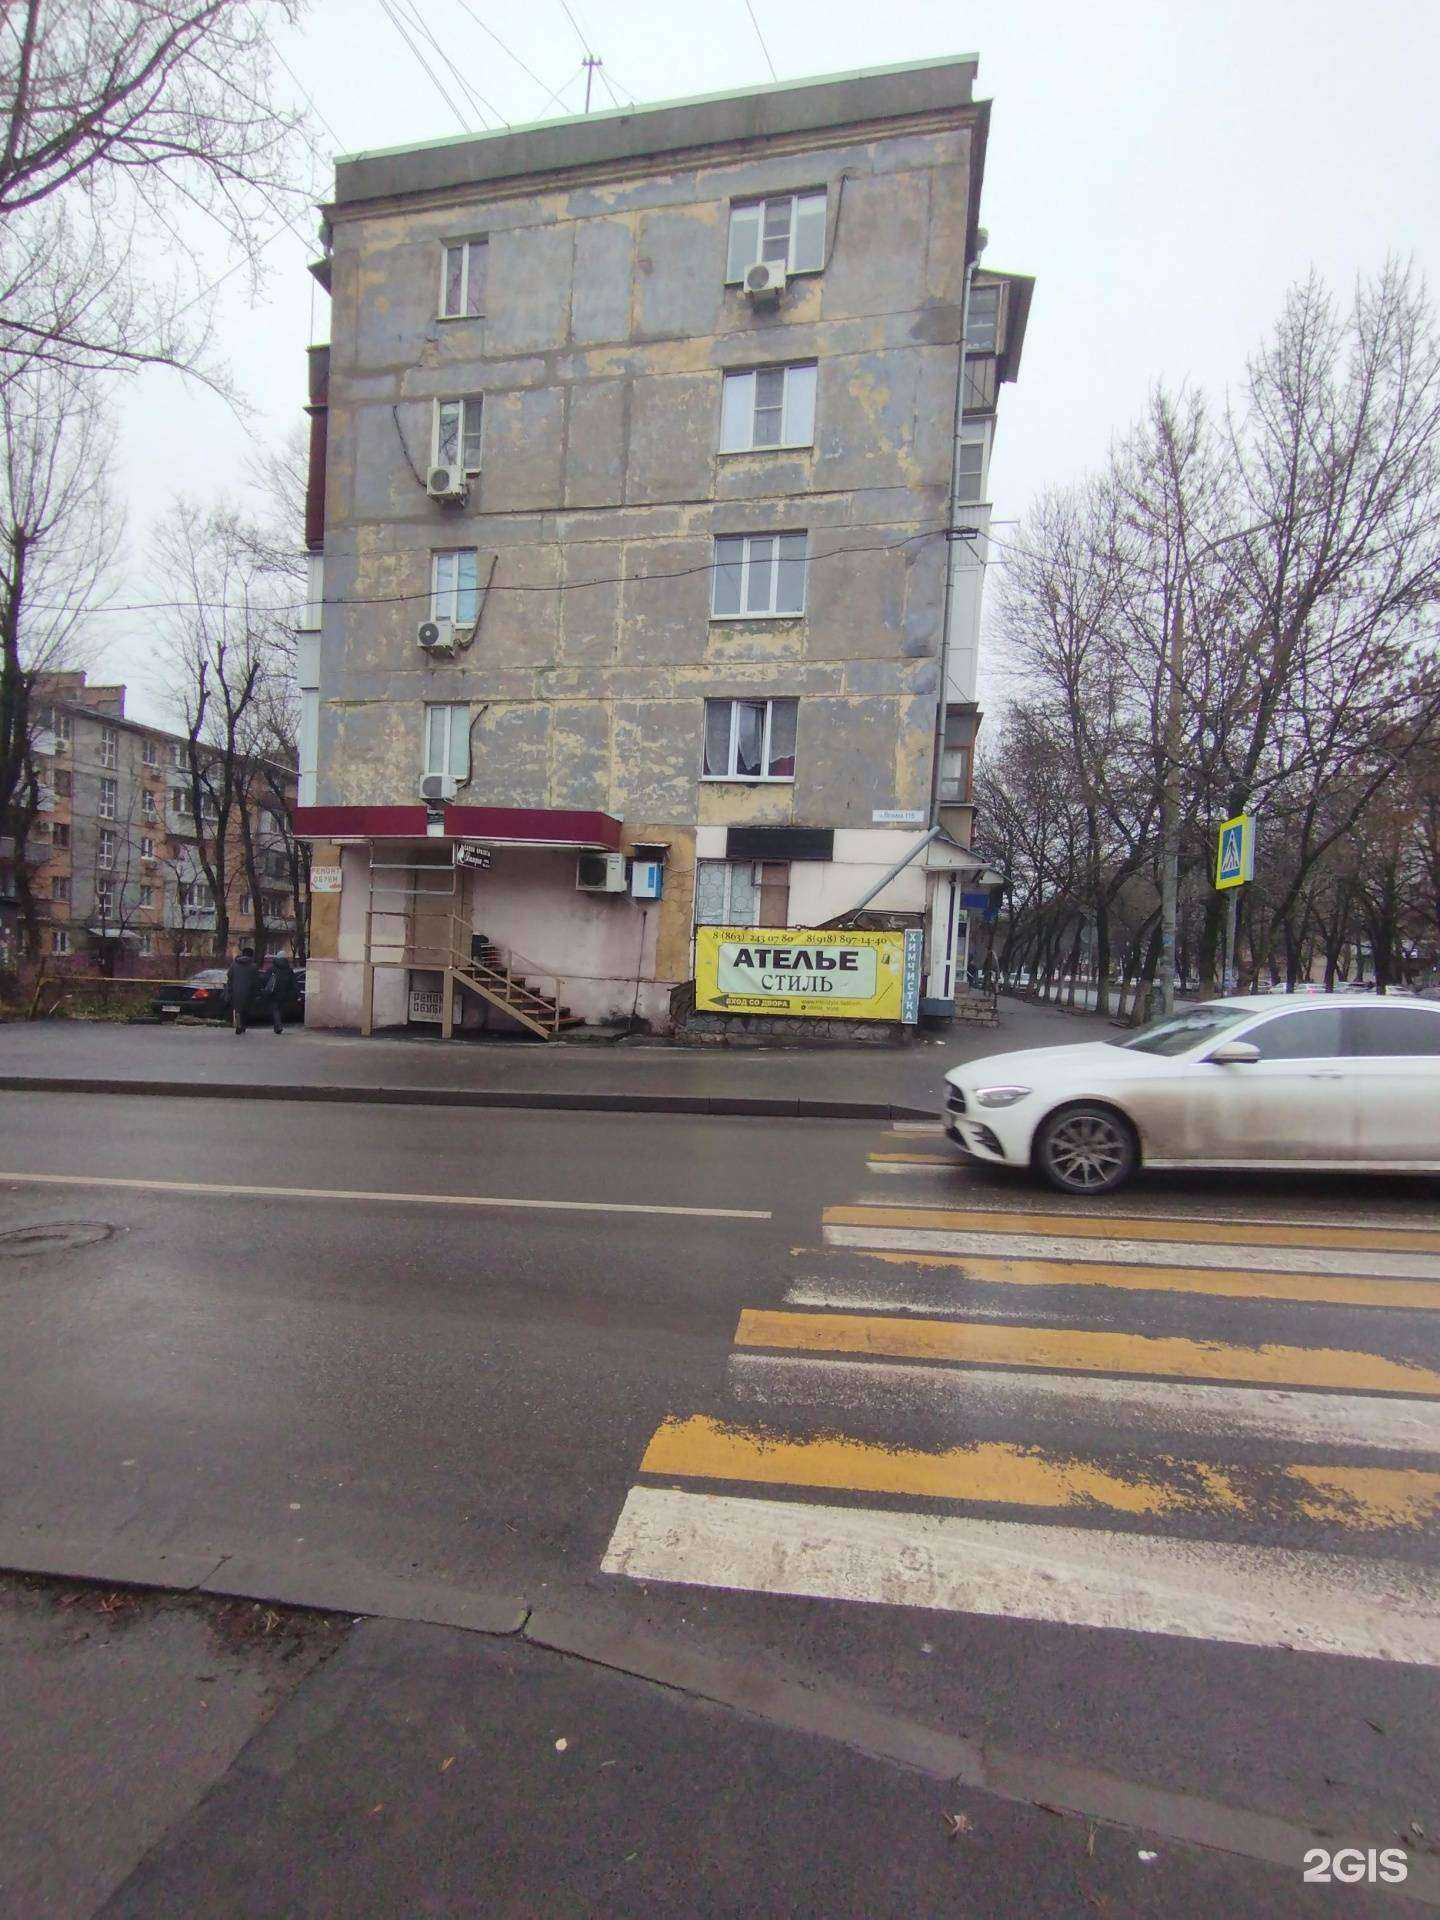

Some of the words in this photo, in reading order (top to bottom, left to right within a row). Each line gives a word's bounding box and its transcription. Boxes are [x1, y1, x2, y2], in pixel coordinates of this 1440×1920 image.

[733, 948, 859, 971] АТЕЛЬЕ
[761, 974, 833, 992] СТИЛЬ
[905, 933, 917, 1020] ХИМЧИСТКА
[726, 998, 748, 1006] ВХОД
[761, 1000, 788, 1008] ДВОРА
